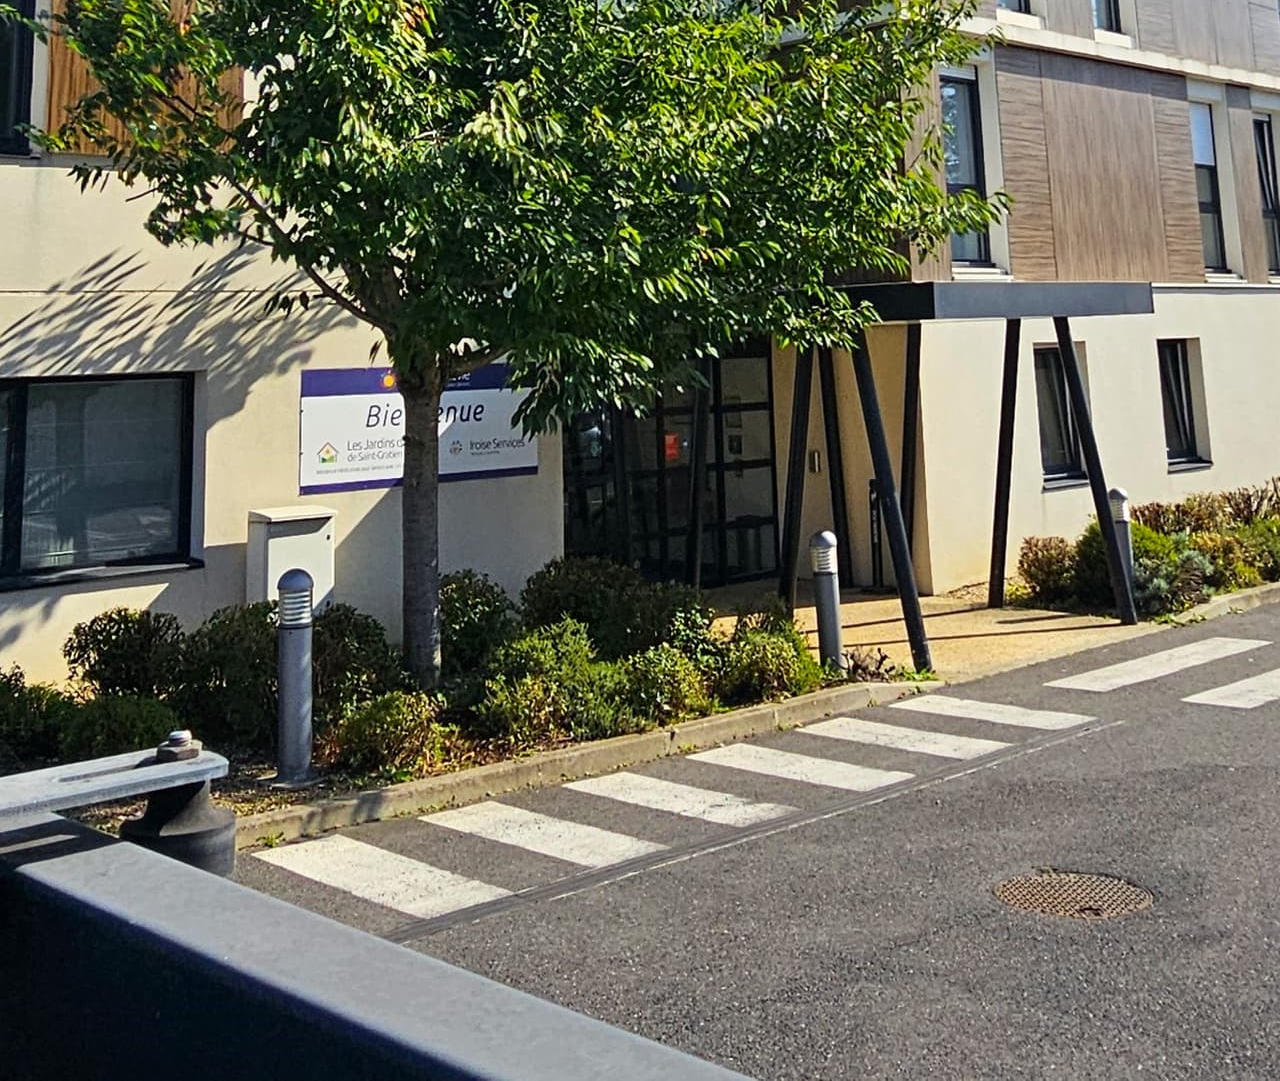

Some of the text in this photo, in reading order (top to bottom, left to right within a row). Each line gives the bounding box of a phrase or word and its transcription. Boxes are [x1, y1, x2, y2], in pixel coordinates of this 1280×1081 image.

[366, 403, 485, 428] Bieenue
[346, 440, 363, 452] Les
[363, 437, 396, 450] Jardins
